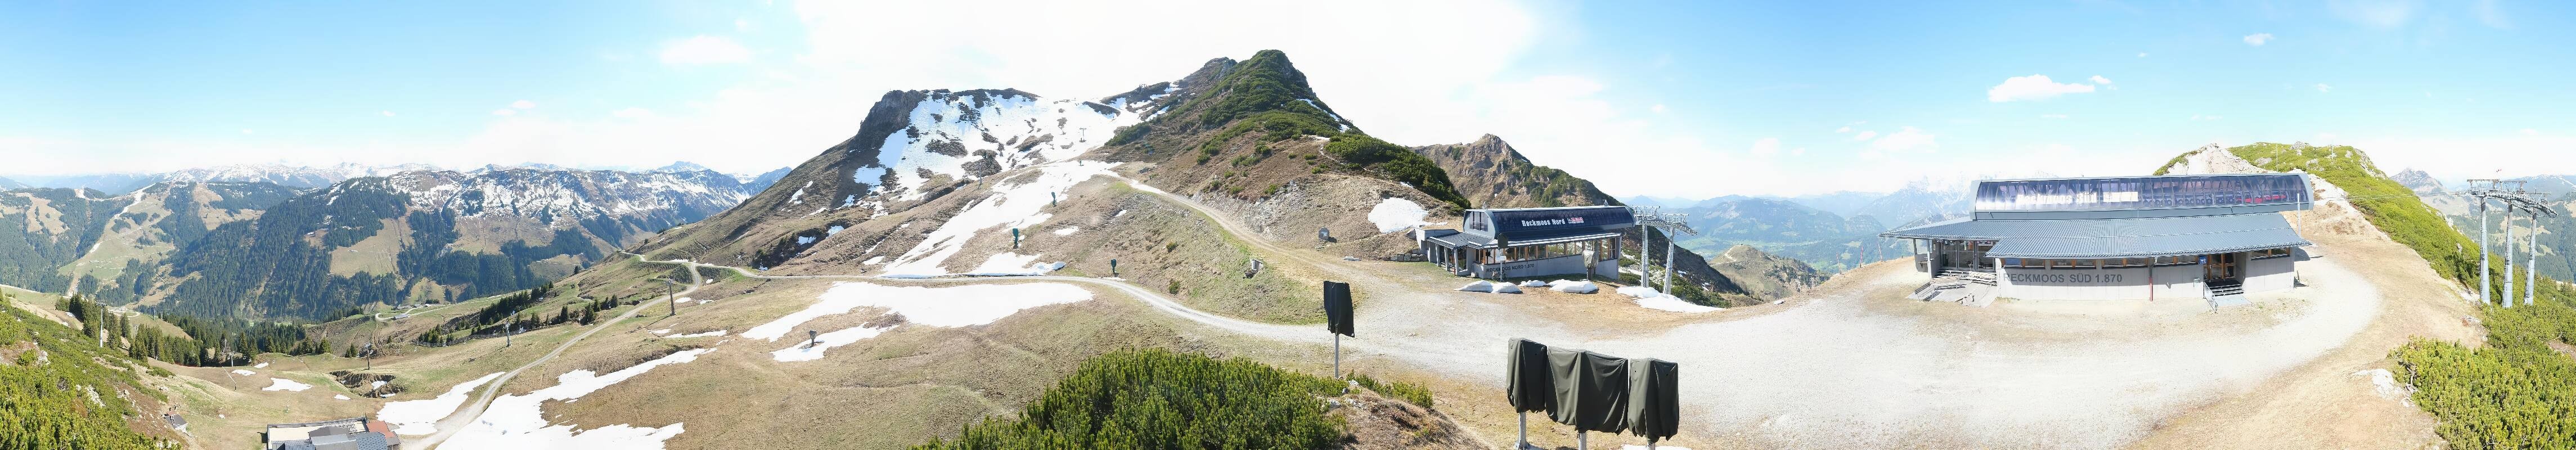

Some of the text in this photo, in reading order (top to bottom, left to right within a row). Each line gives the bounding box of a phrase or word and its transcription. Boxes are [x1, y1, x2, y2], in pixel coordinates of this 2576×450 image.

[2003, 273, 2123, 283] RECKMOOS SÜD 1.870
